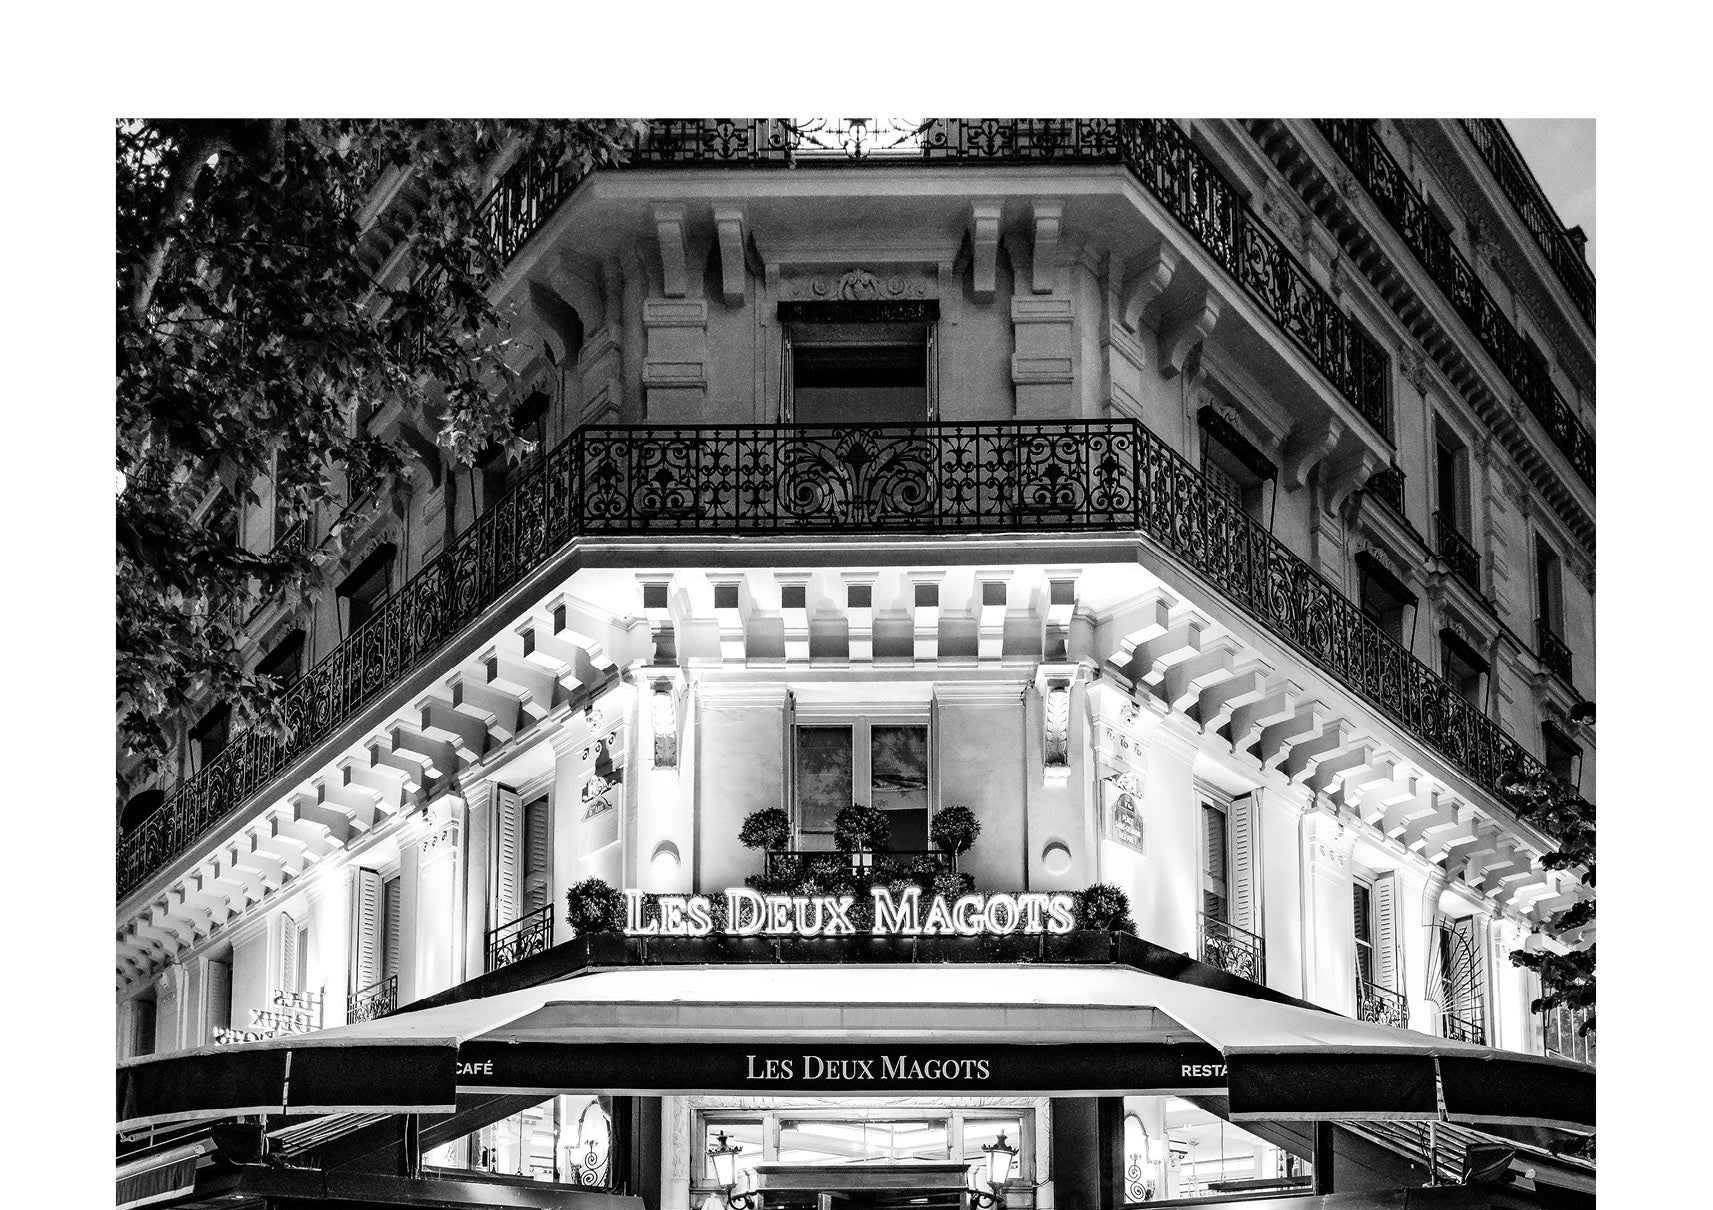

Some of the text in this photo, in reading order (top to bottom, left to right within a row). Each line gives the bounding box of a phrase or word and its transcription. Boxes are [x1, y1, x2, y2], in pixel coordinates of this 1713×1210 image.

[624, 886, 1075, 936] LES DEUX MAGOTS
[746, 1055, 990, 1080] LES DEUX MAGOTS
